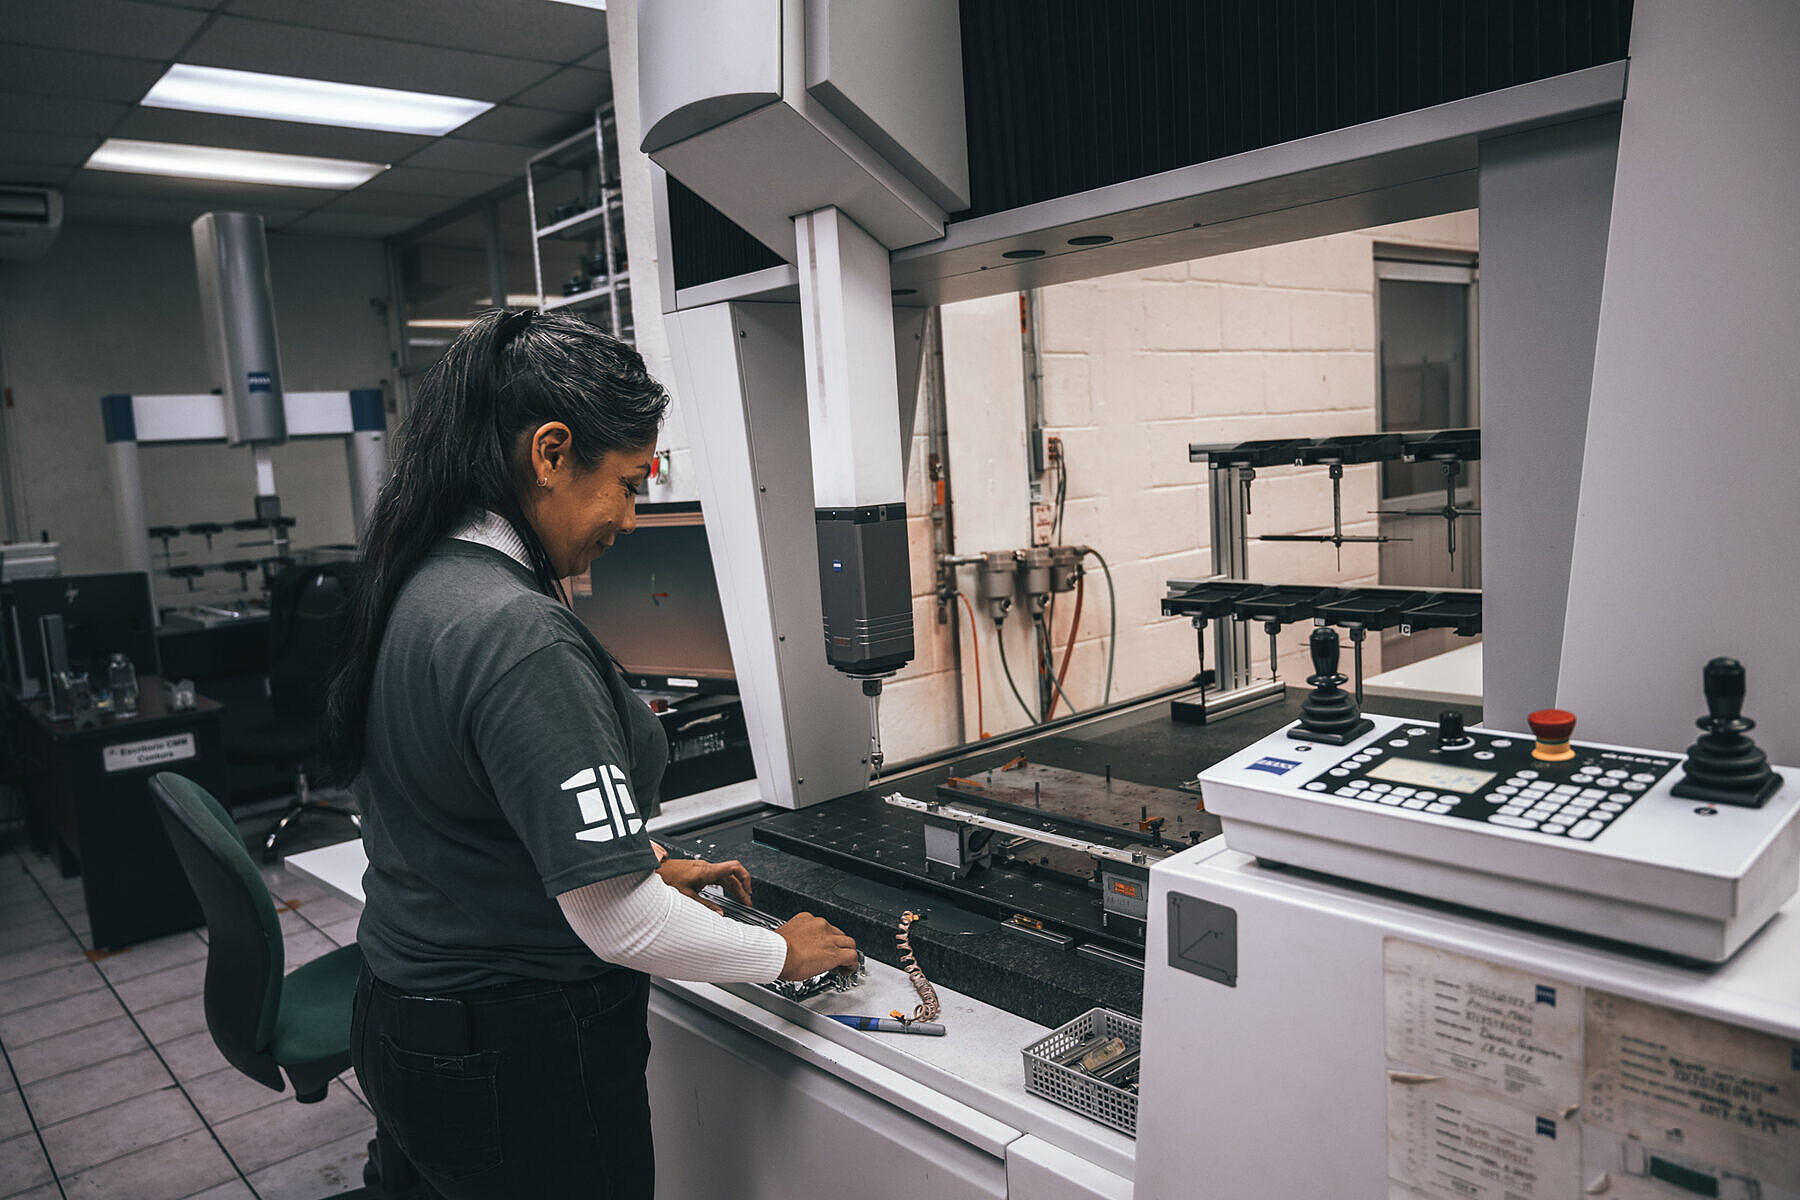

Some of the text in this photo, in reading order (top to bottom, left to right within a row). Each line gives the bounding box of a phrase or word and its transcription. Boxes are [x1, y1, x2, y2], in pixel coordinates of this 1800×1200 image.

[120, 737, 188, 756] Escritorio CMM
[137, 751, 174, 763] Contura
